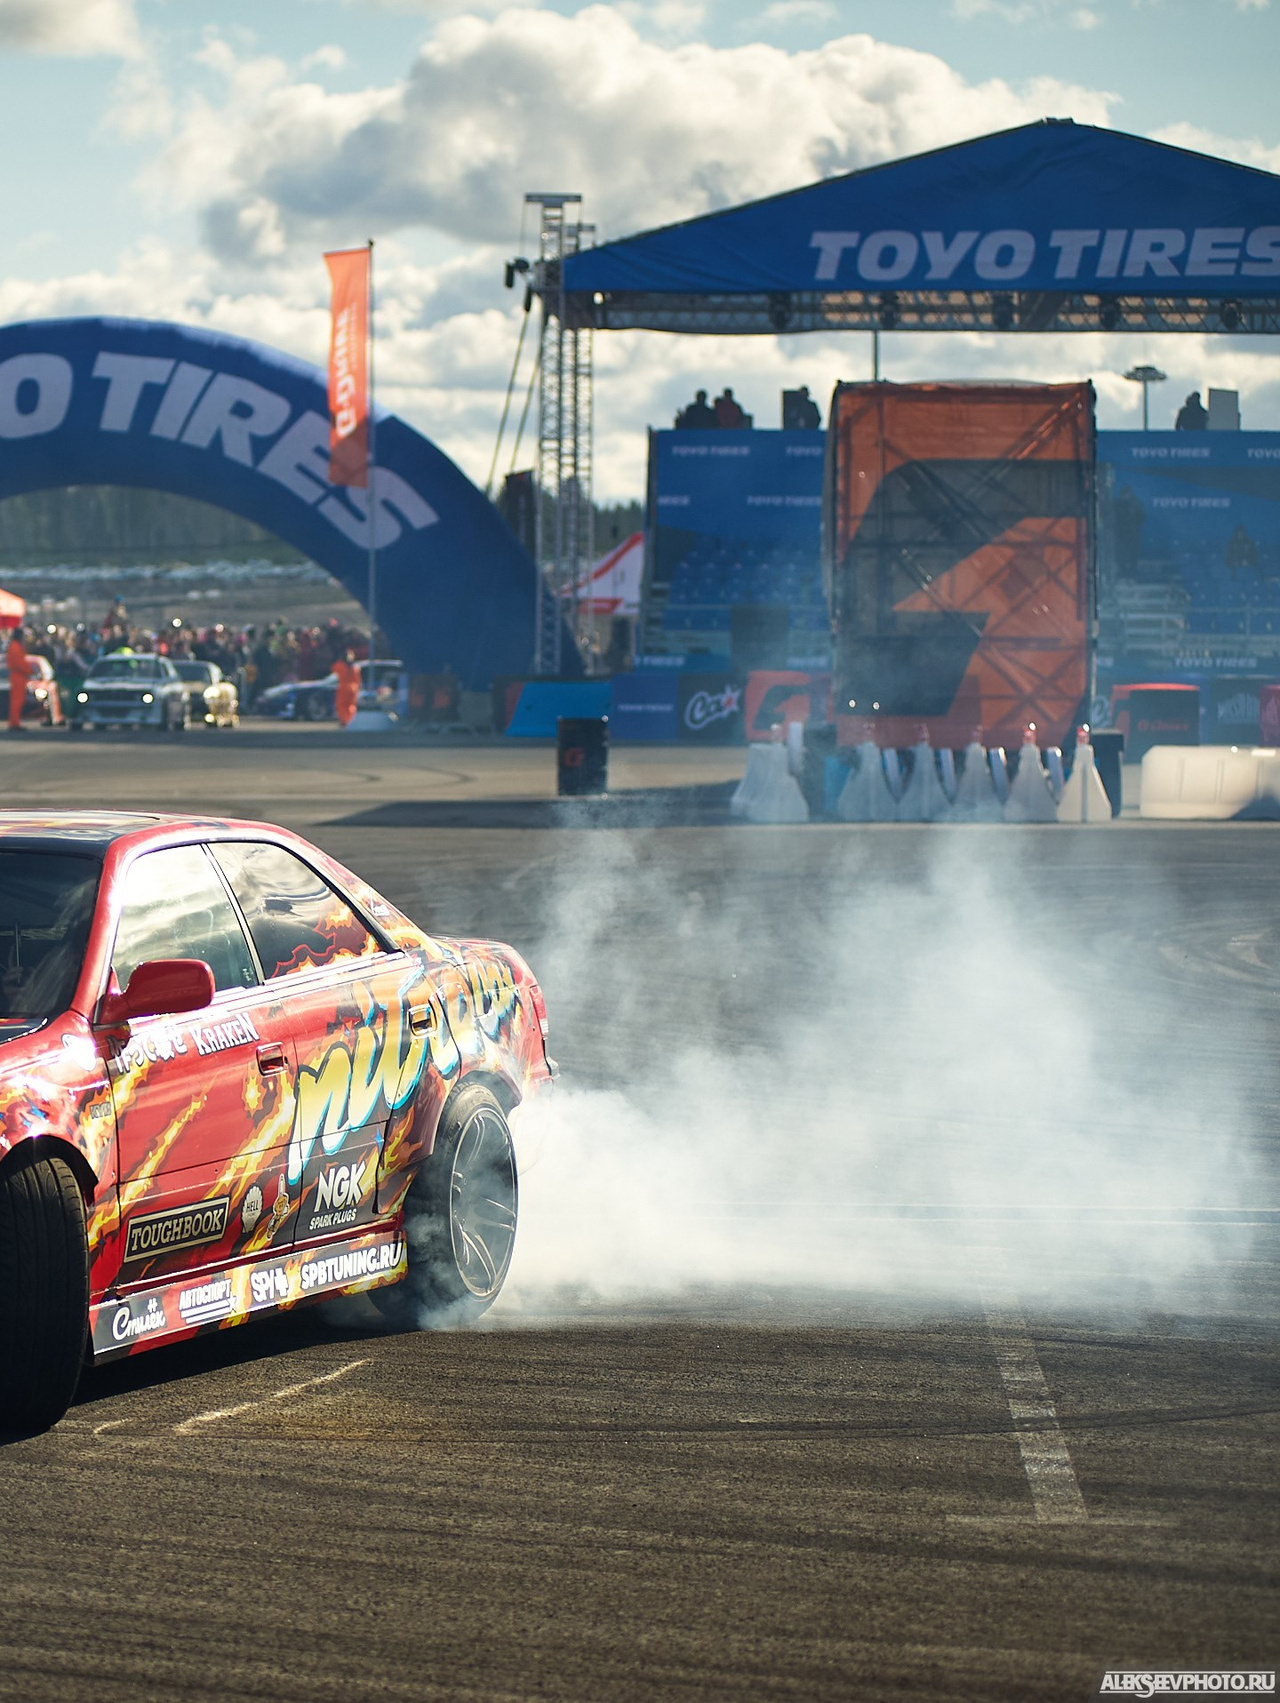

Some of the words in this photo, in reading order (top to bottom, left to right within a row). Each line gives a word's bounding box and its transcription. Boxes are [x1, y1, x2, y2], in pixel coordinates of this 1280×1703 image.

[809, 229, 1036, 281] TOYO
[1049, 225, 1280, 278] TIRES
[92, 351, 439, 551] TIRES
[190, 1012, 260, 1056] KRAKEN
[314, 1160, 366, 1213] NGK
[131, 1209, 224, 1252] TOUGHBOOK
[309, 1213, 334, 1230] SPARK
[332, 1208, 357, 1226] PLUGS
[301, 1242, 402, 1290] SPBTUNING.RU
